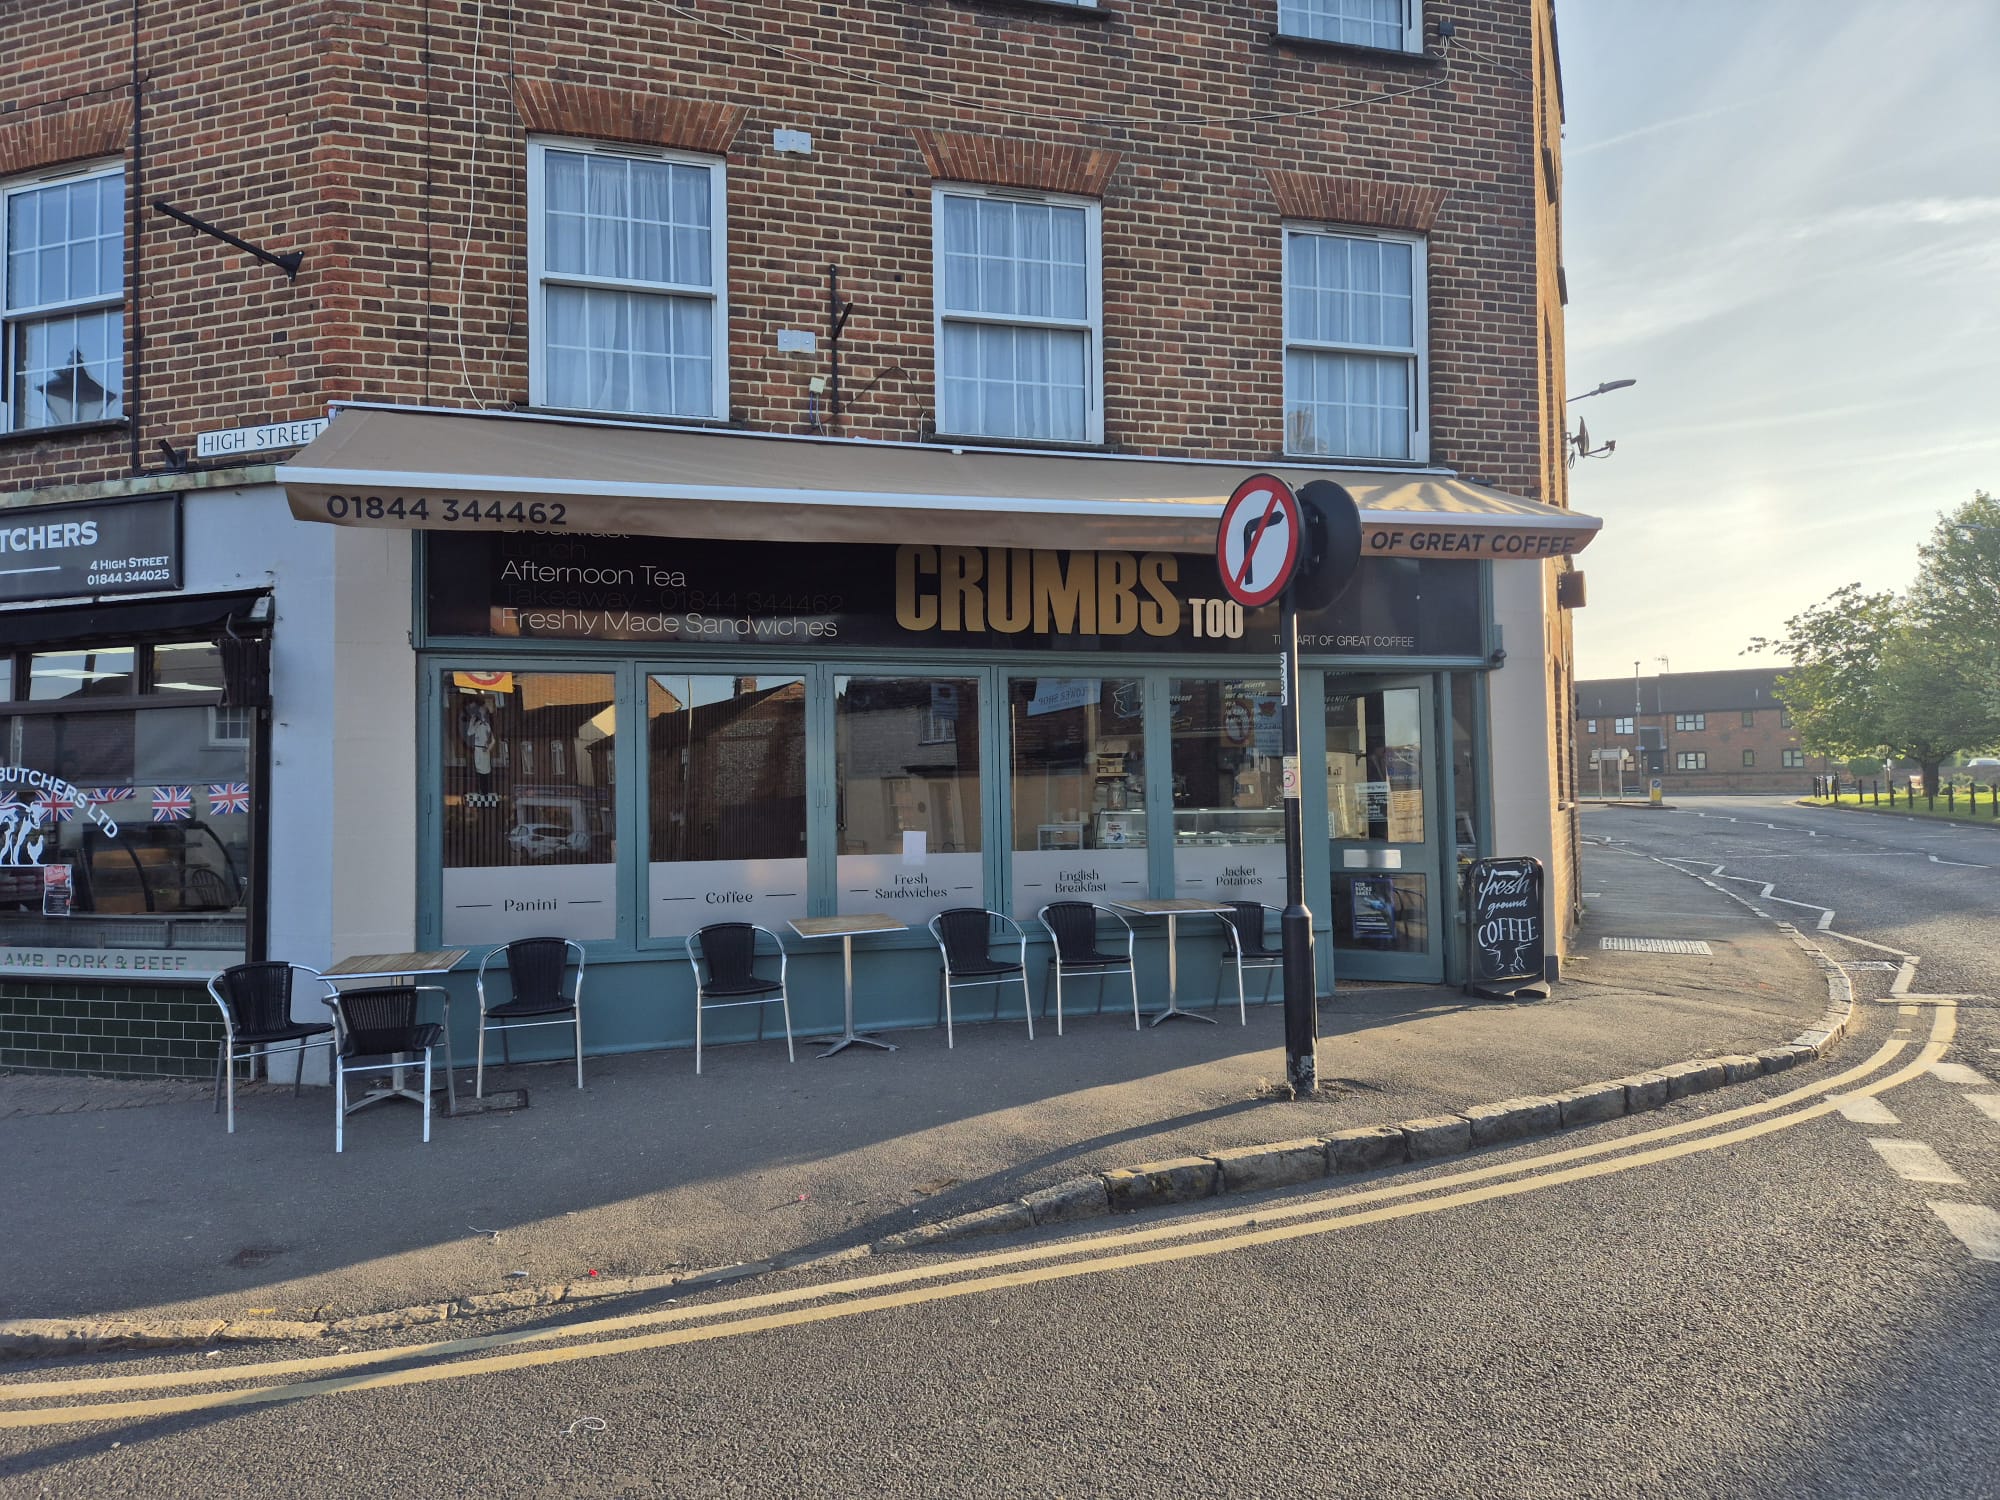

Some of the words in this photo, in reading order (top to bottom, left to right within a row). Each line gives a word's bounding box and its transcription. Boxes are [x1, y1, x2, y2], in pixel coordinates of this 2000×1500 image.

[203, 431, 246, 453] HIGH
[256, 422, 322, 446] STREET
[326, 495, 430, 520] 01844
[442, 499, 567, 525] 344462
[1371, 531, 1404, 550] OF
[1410, 532, 1485, 551] GREAT
[1491, 534, 1575, 553] COFFEE
[90, 560, 98, 571] 4
[500, 559, 634, 585] Afternoon
[640, 565, 687, 588] Tea
[87, 573, 122, 586] 01844
[124, 569, 170, 583] 344025
[504, 583, 638, 610] Takeaway
[895, 543, 1181, 637] CRUMBS
[1188, 598, 1244, 639] TOO
[502, 607, 597, 635] Freshly
[603, 610, 680, 634] Made
[685, 612, 838, 637] Sandwiches
[1319, 634, 1334, 646] OF
[1337, 635, 1371, 647] GREAT
[1373, 636, 1415, 648] COFFEE
[0, 766, 88, 809] BUTCHERS
[88, 802, 118, 838] LTD
[895, 872, 928, 885] Fresh
[1059, 868, 1099, 884] English
[1221, 865, 1256, 876] Jacket
[1055, 882, 1106, 893] Breakfast
[1216, 876, 1263, 886] Potatoes
[1478, 868, 1530, 910] fresh
[705, 891, 753, 905] Coffee
[875, 885, 948, 899] Sandwiches
[504, 898, 558, 912] Panini
[1485, 897, 1528, 919] ground
[1477, 917, 1539, 948] COFFEE
[56, 954, 108, 969] PORK
[115, 955, 128, 970] &
[134, 956, 188, 971] BEEF
